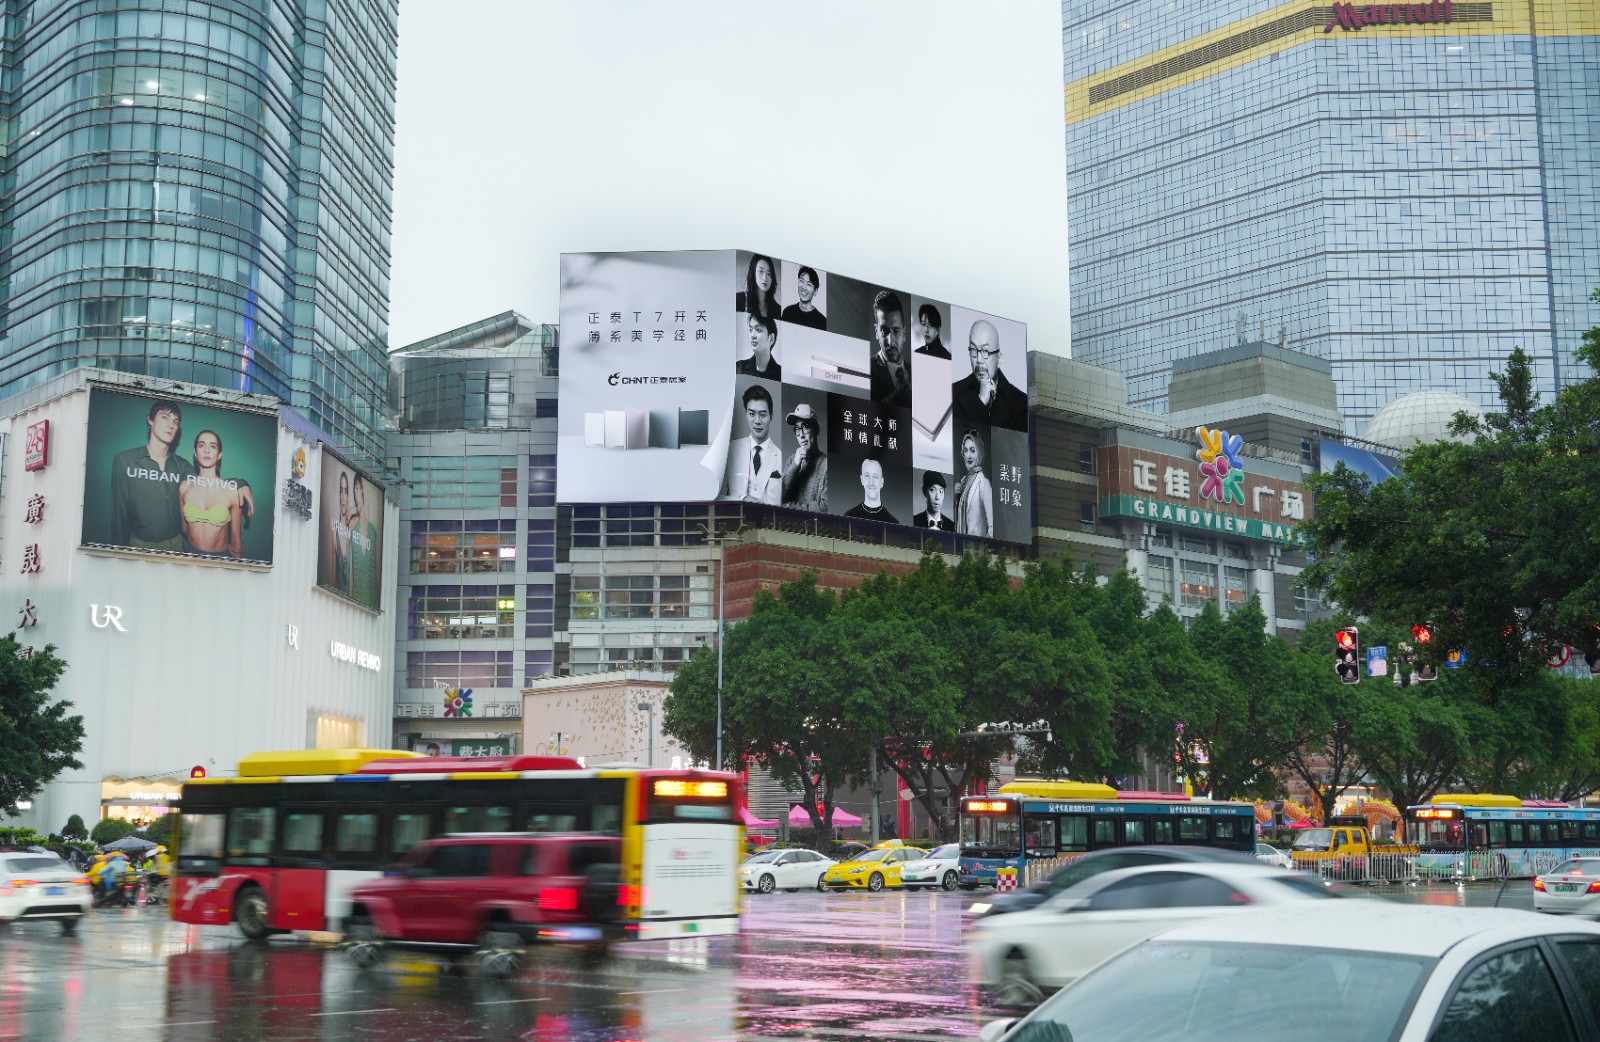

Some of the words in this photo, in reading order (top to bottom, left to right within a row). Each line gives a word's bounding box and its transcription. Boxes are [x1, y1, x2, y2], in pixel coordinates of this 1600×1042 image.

[1324, 0, 1452, 33] Marriott
[588, 310, 707, 325] 正泰T7开关
[843, 410, 897, 431] 全球大师
[843, 428, 898, 450] 倾情礼献
[126, 467, 180, 483] URBAN
[186, 474, 238, 490] REVIVO
[1133, 459, 1191, 499] 正佳
[1252, 485, 1305, 520] 广场
[1000, 487, 1022, 506] 印象
[1134, 499, 1247, 533] GRANDVIEW
[331, 519, 351, 540] URBAN
[353, 530, 370, 550] REVIVO
[330, 640, 356, 663] URBAN
[356, 649, 380, 671] REVIVO
[396, 703, 435, 718] 正佳
[482, 703, 521, 718] 广场
[130, 792, 163, 800] URBAN
